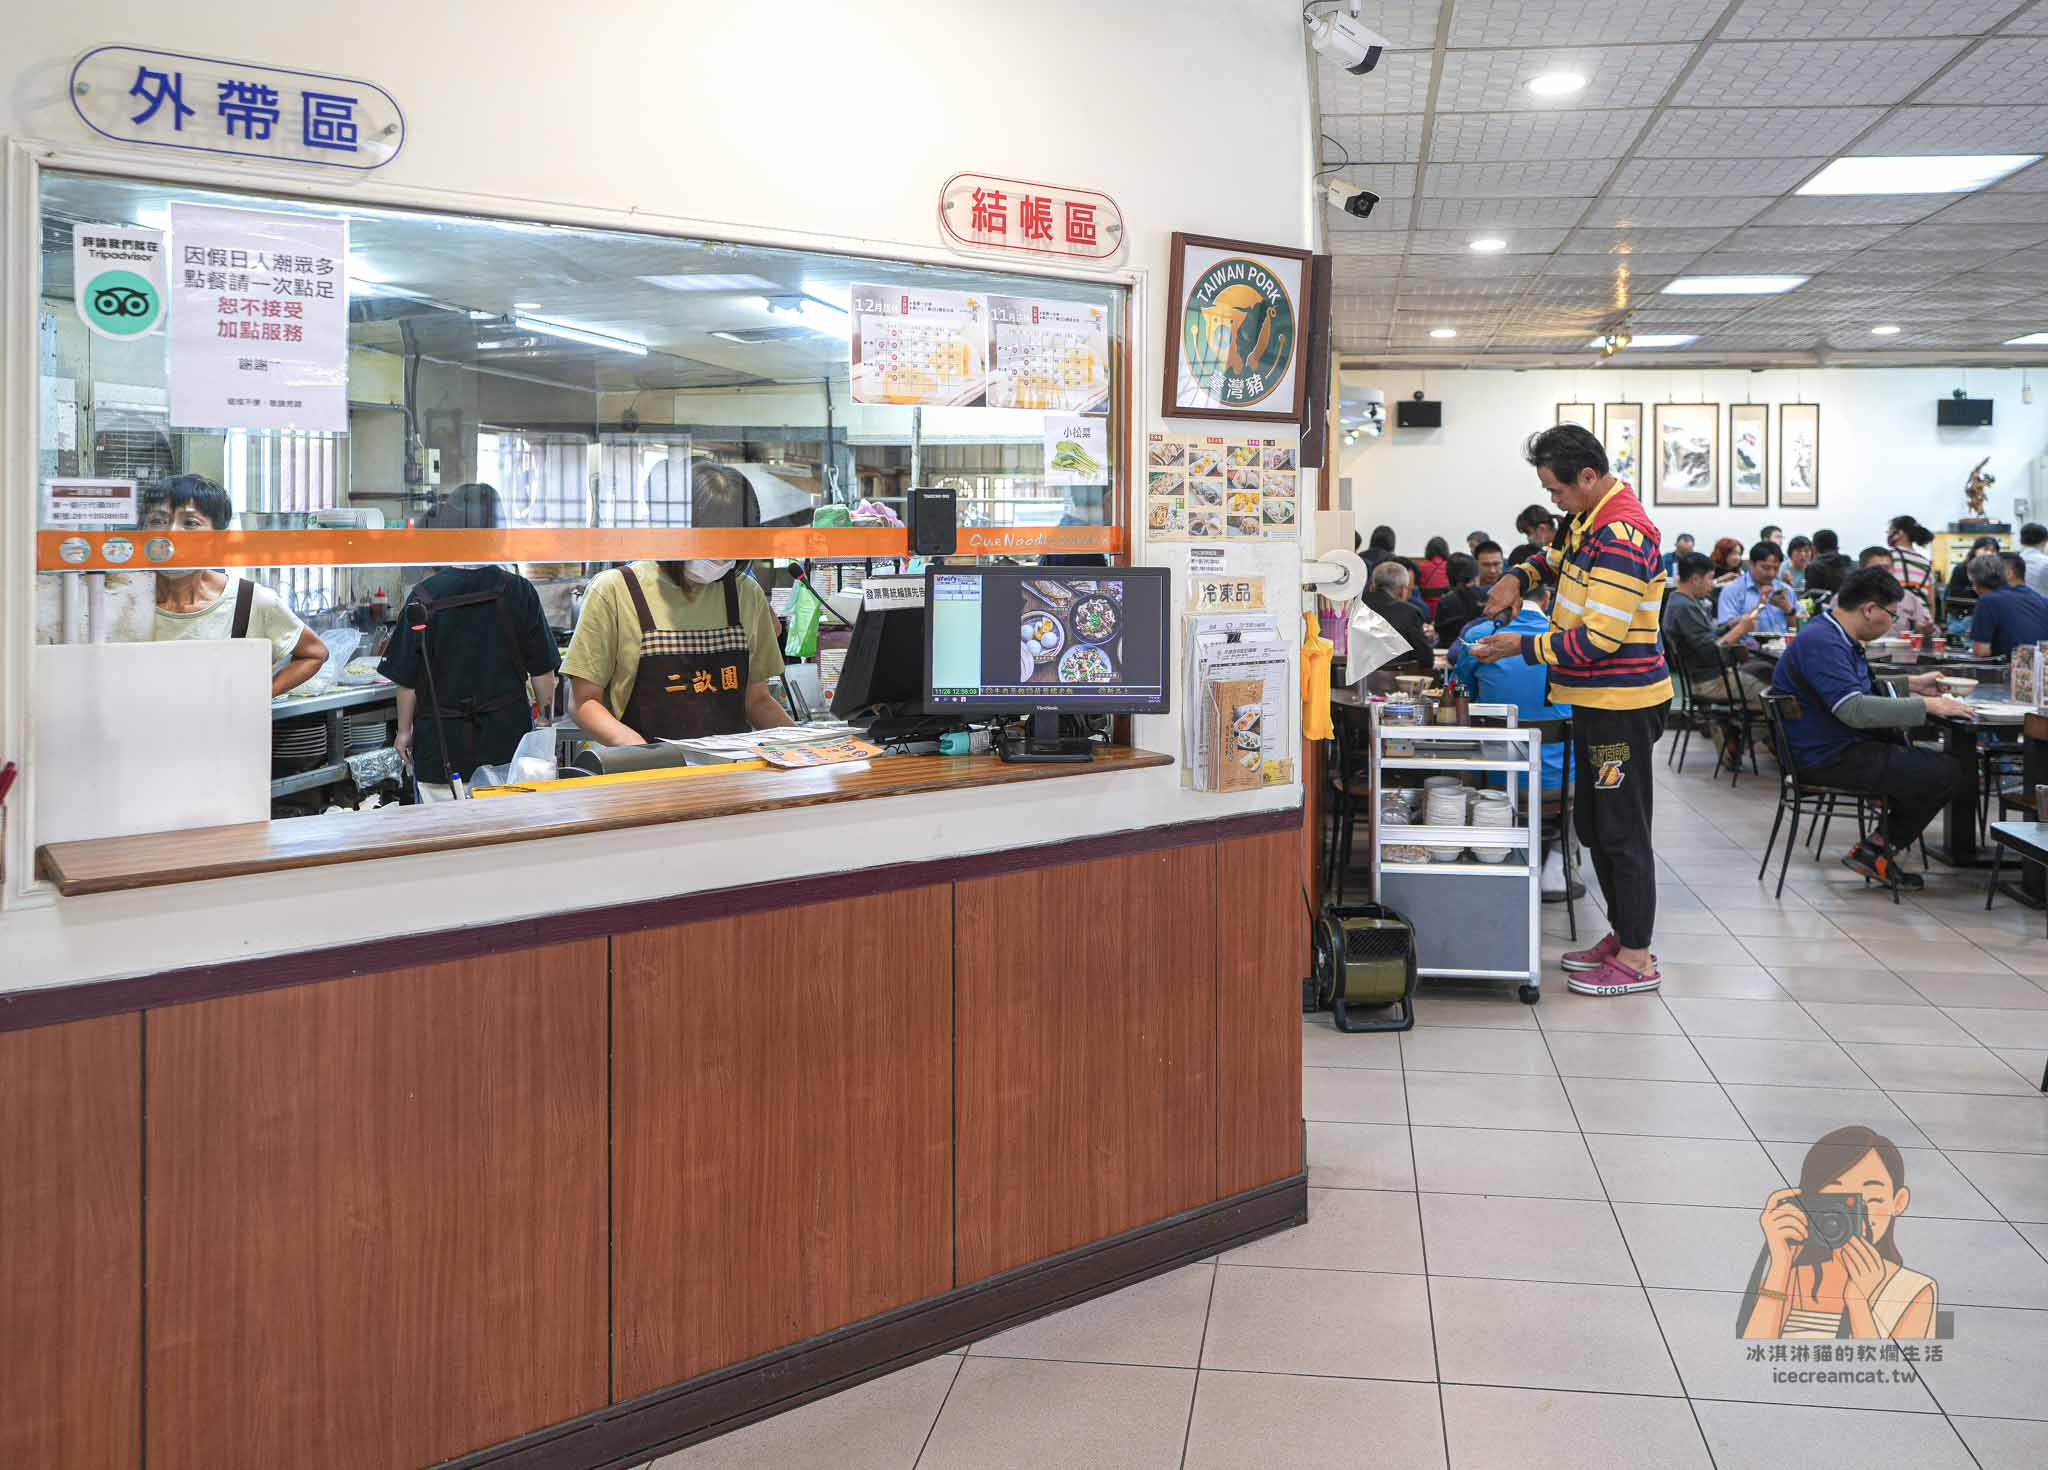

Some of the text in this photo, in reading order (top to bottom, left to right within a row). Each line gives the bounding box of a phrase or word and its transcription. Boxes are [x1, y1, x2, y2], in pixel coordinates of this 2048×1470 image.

[129, 66, 359, 153] 外帶區
[971, 187, 1097, 246] 結帳區
[88, 249, 153, 261] Tripadvisor
[184, 245, 335, 276] 因假日人潮眾多
[184, 269, 335, 299] 點餐請一次點足
[1196, 264, 1281, 304] TAIWAN PORK
[217, 296, 303, 320] 恕不接受
[217, 319, 303, 343] 加點服務
[1207, 371, 1265, 400] 臺灣豬
[1203, 583, 1251, 603] 冷凍品
[1596, 985, 1629, 994] crocs
